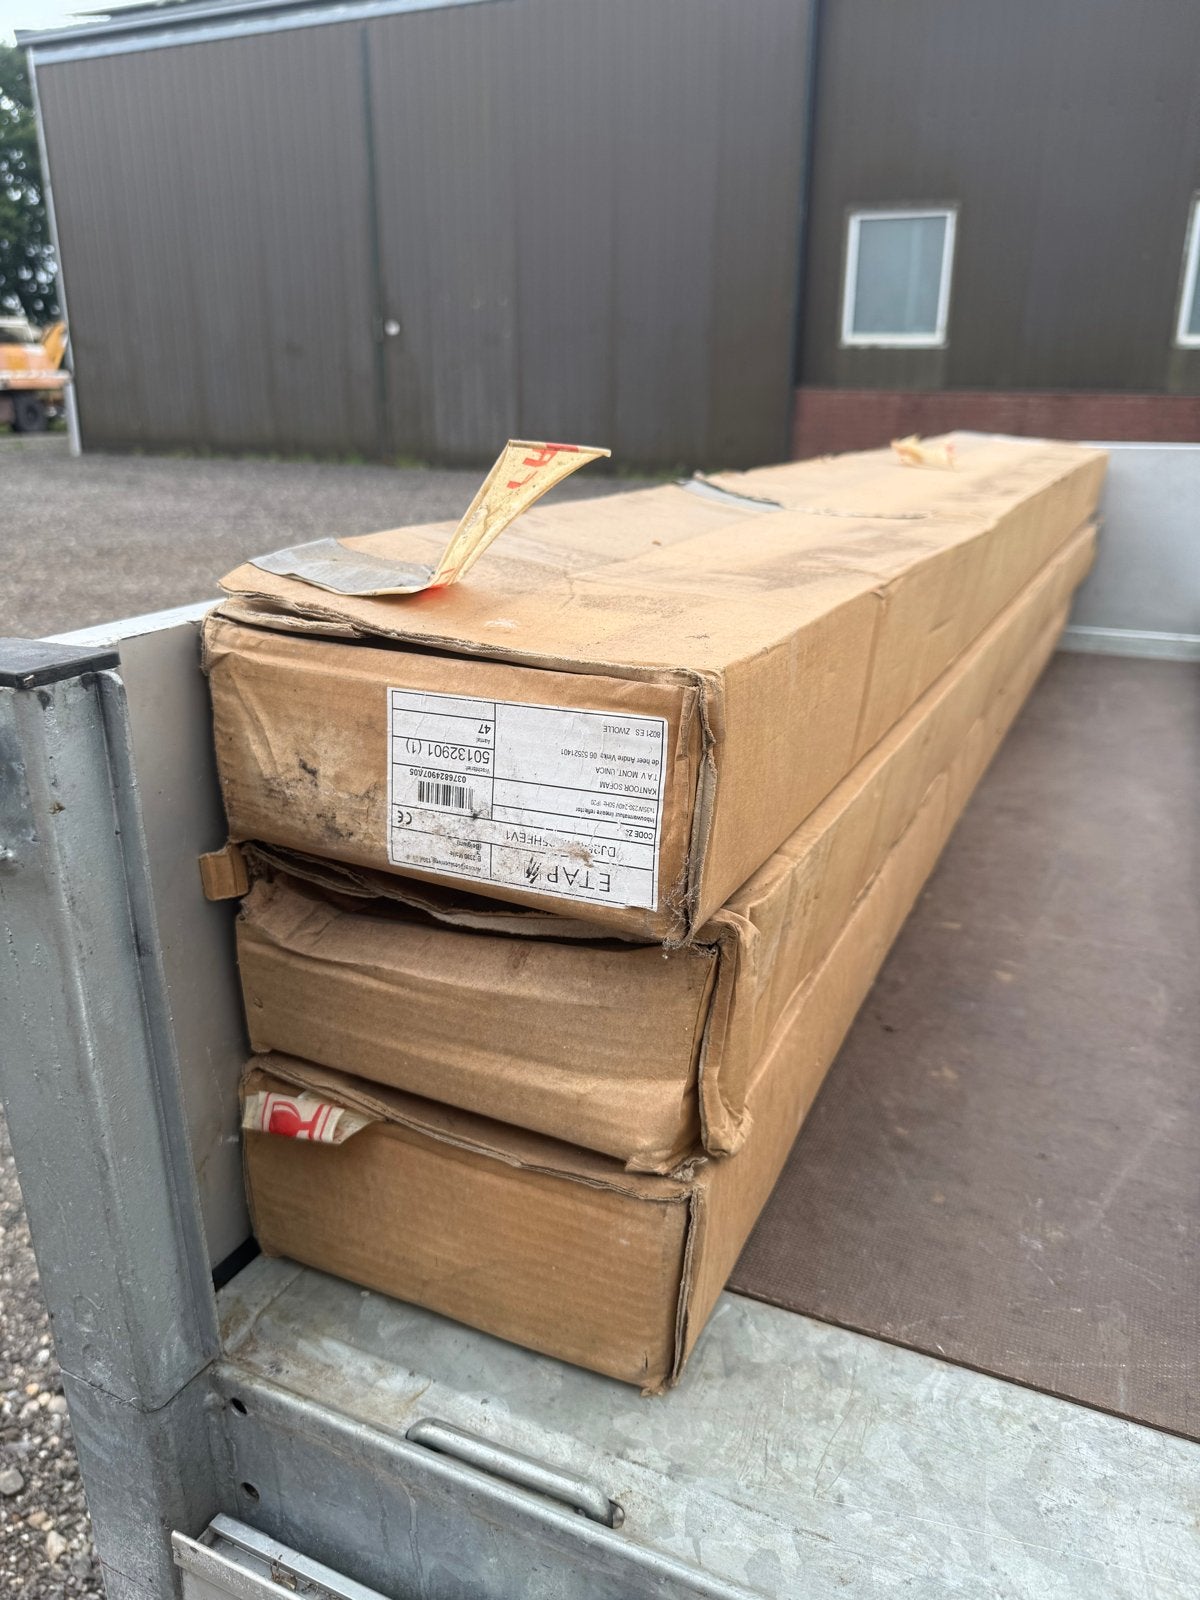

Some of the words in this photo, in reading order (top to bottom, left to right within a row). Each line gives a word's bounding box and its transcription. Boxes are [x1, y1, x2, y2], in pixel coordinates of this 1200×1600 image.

[478, 724, 491, 734] 47
[603, 725, 630, 735] ZWOLLE
[635, 728, 644, 737] ES
[406, 738, 421, 754] (1)
[428, 744, 490, 764] 50132901
[590, 751, 597, 759] 06
[617, 755, 635, 764] Andre
[595, 767, 615, 775] UNICA
[599, 781, 622, 790] SOFAM
[624, 784, 656, 795] KANTOOR
[634, 830, 653, 839] CODE
[546, 865, 610, 892] ETAP
